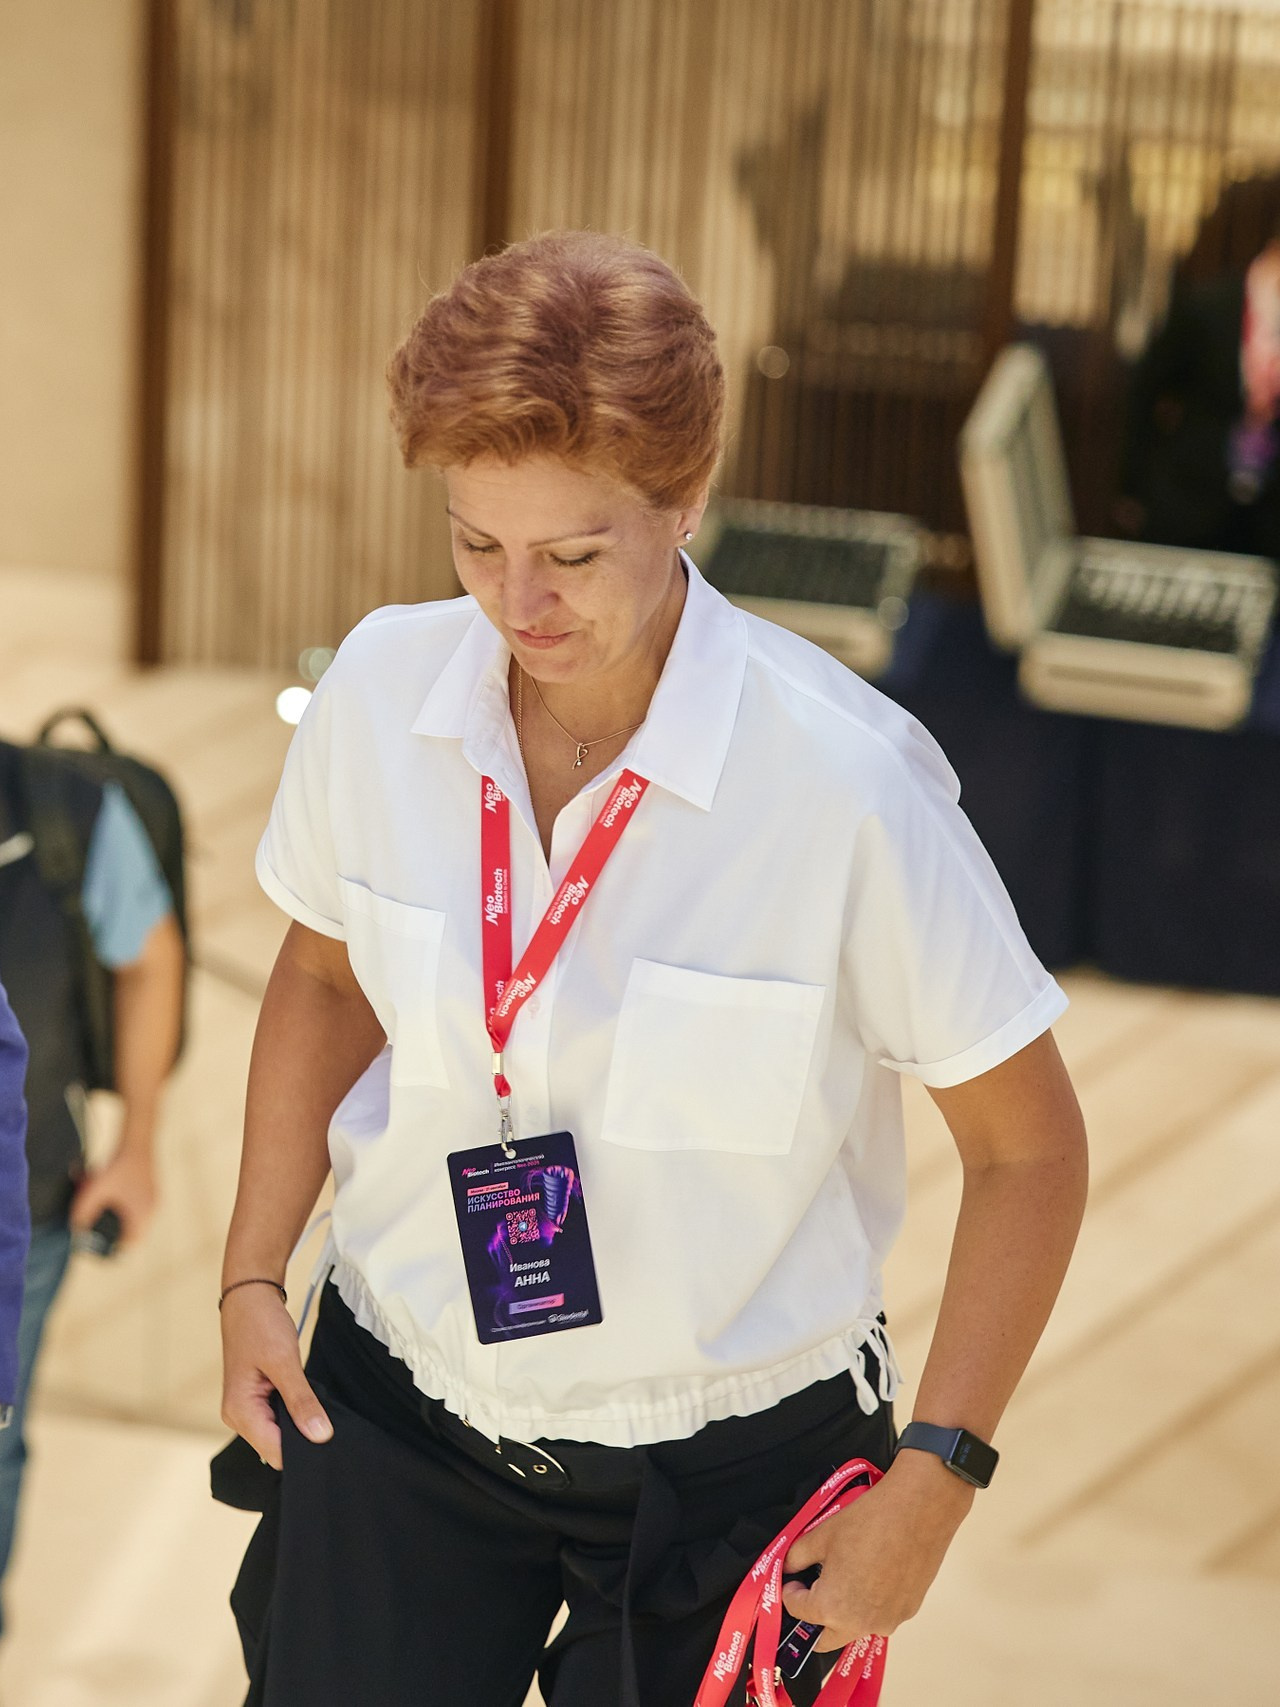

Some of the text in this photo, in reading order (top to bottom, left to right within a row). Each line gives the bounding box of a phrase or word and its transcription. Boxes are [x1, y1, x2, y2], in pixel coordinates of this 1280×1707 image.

[484, 783, 497, 814] Neo
[603, 787, 630, 828] Biotech
[624, 778, 643, 808] Neo
[493, 868, 503, 914] Biotech
[550, 883, 578, 924] Biotech
[571, 875, 589, 905] Neo
[484, 895, 498, 926] Neo
[499, 980, 524, 1017] Biotech
[518, 972, 536, 998] Neo
[467, 1168, 489, 1178] Biotech
[467, 1188, 520, 1205] ИСКУССТВО
[467, 1192, 540, 1213] ПЛАНИРОВАНИЯ
[509, 1258, 551, 1273] Иванова
[514, 1271, 551, 1288] АННА
[768, 1558, 780, 1603] Biotech
[762, 1583, 771, 1614] Neo
[723, 1630, 742, 1673] Biotech
[713, 1652, 727, 1682] Neo
